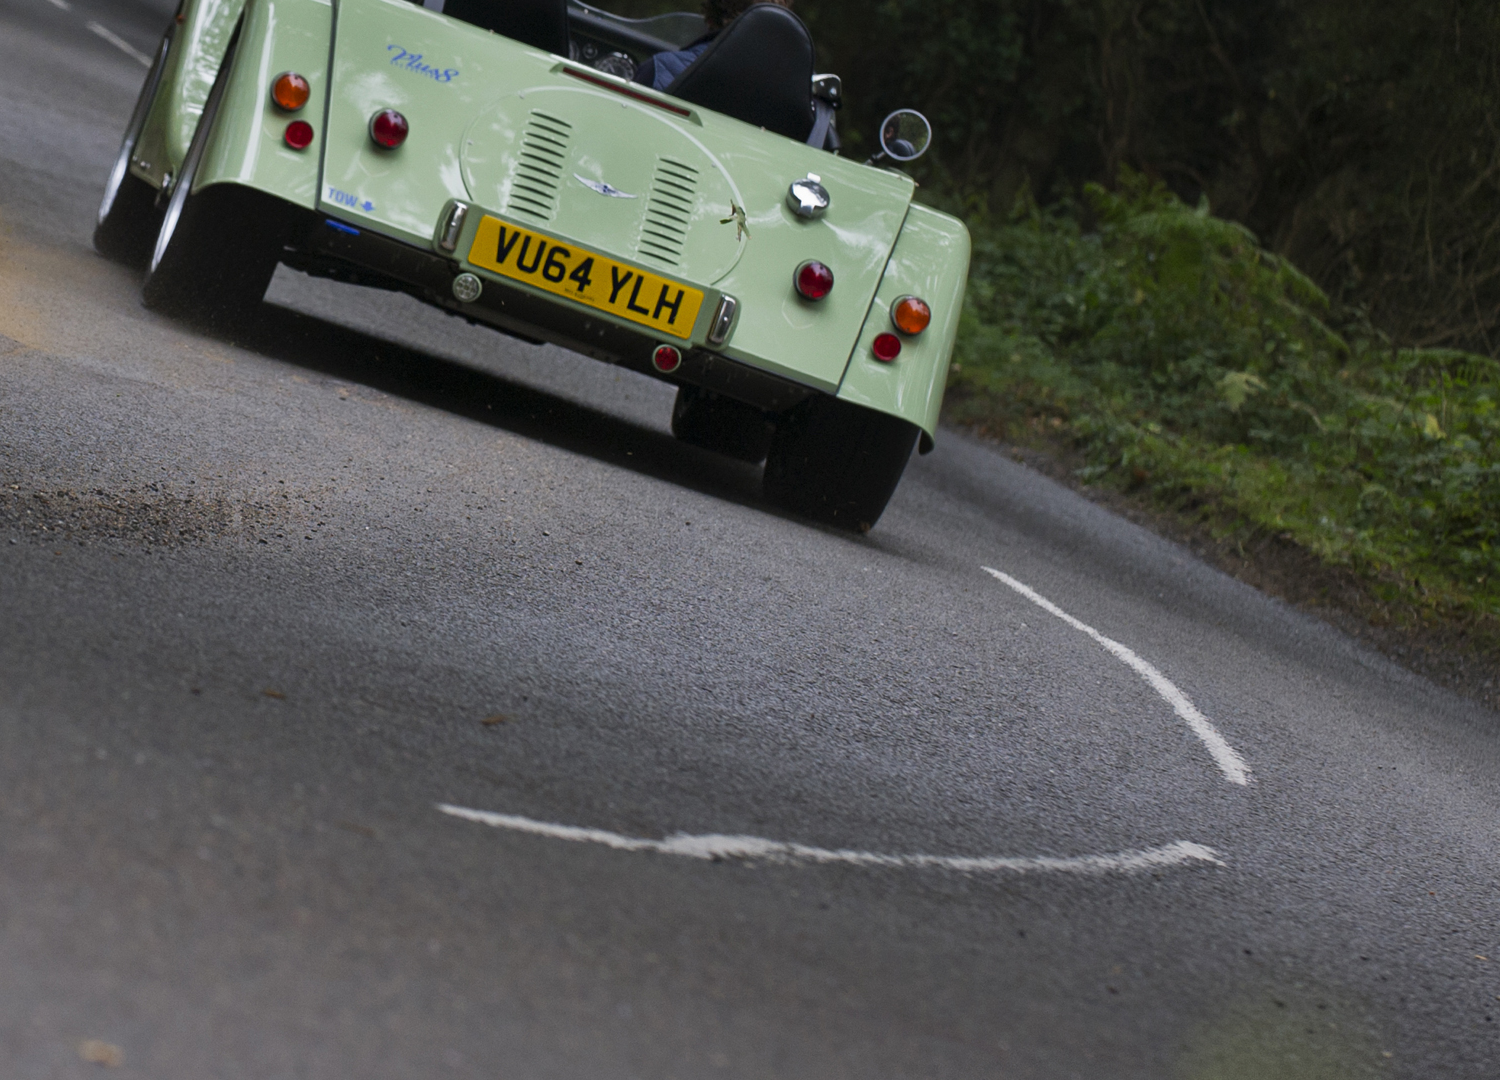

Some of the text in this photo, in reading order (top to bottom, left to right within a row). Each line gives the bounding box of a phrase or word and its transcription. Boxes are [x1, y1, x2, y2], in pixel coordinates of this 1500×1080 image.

[329, 187, 358, 207] TOW
[496, 226, 685, 325] VU64 YLH
